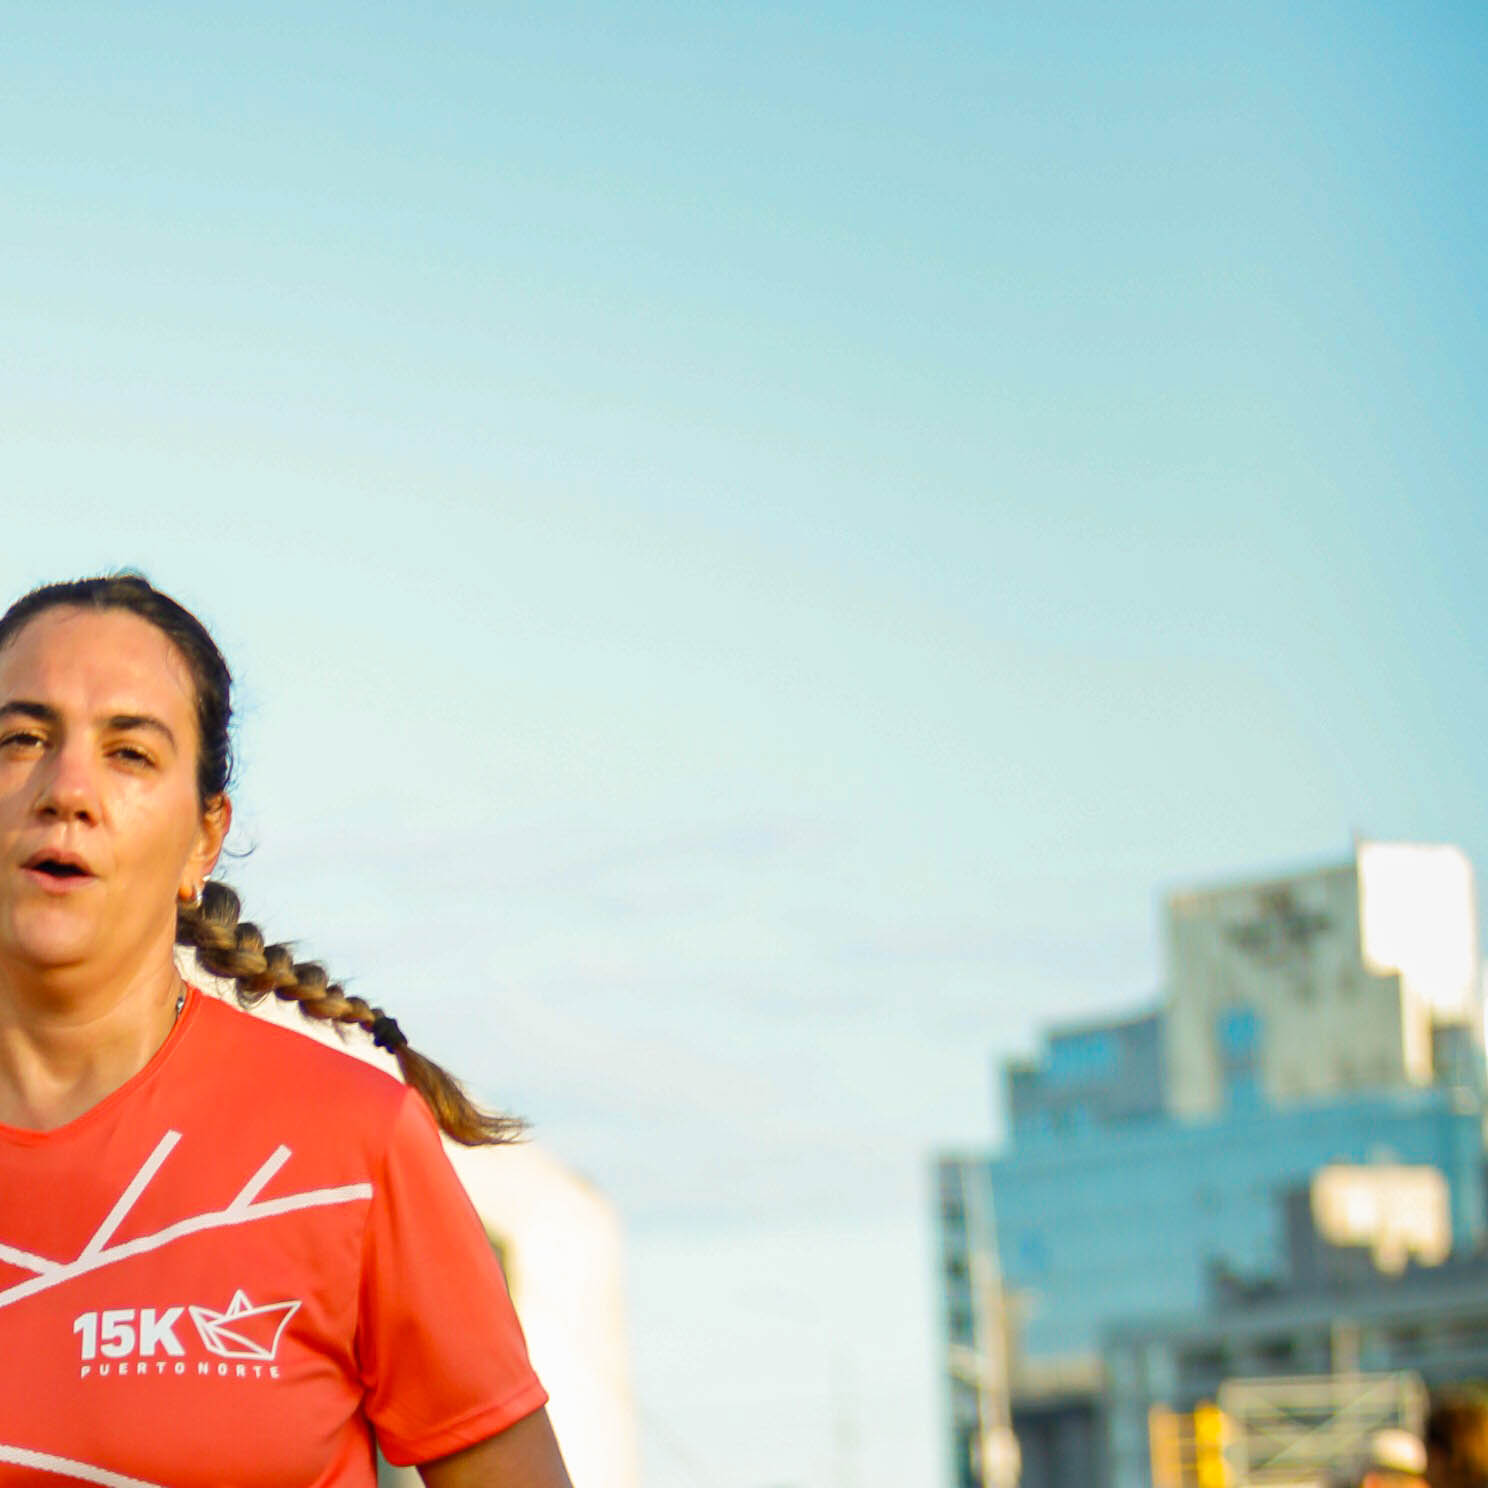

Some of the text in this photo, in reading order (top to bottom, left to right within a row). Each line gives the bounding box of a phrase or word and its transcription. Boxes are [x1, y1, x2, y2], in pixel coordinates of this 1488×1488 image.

[73, 1306, 186, 1361] 15K
[80, 1361, 281, 1379] PUERTO NORTE
